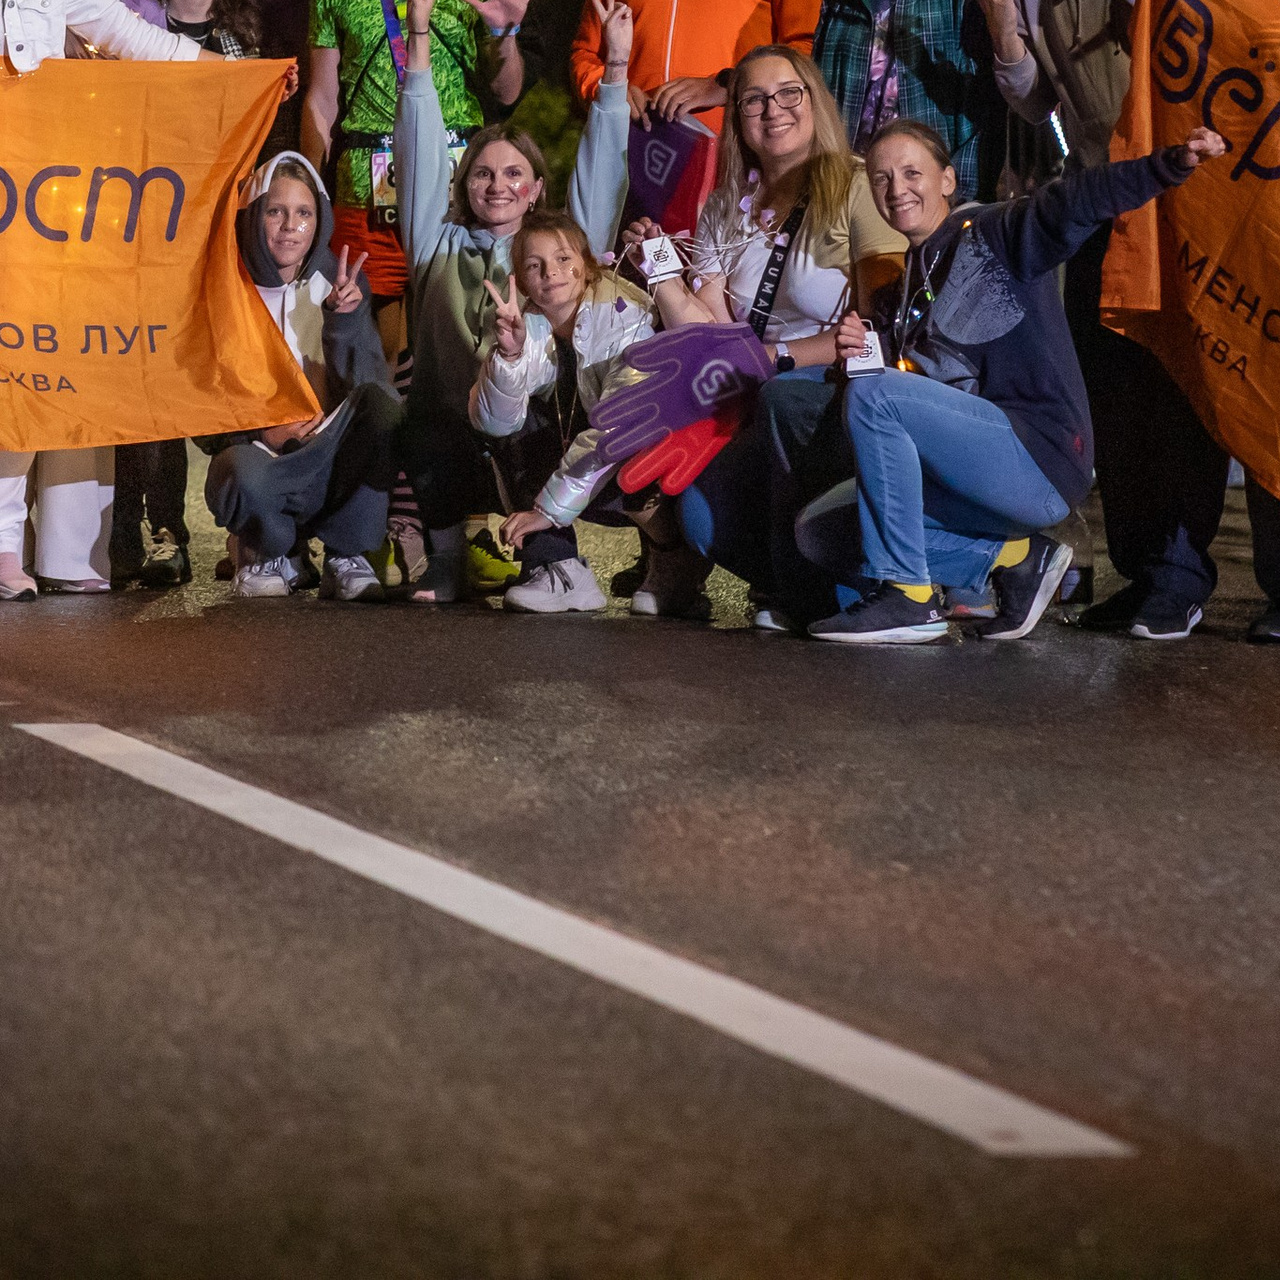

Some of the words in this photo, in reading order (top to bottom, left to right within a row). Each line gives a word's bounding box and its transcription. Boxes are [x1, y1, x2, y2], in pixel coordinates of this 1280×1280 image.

[756, 251, 785, 308] PUMA
[80, 323, 169, 356] ЛУГ
[1193, 323, 1248, 382] КВА
